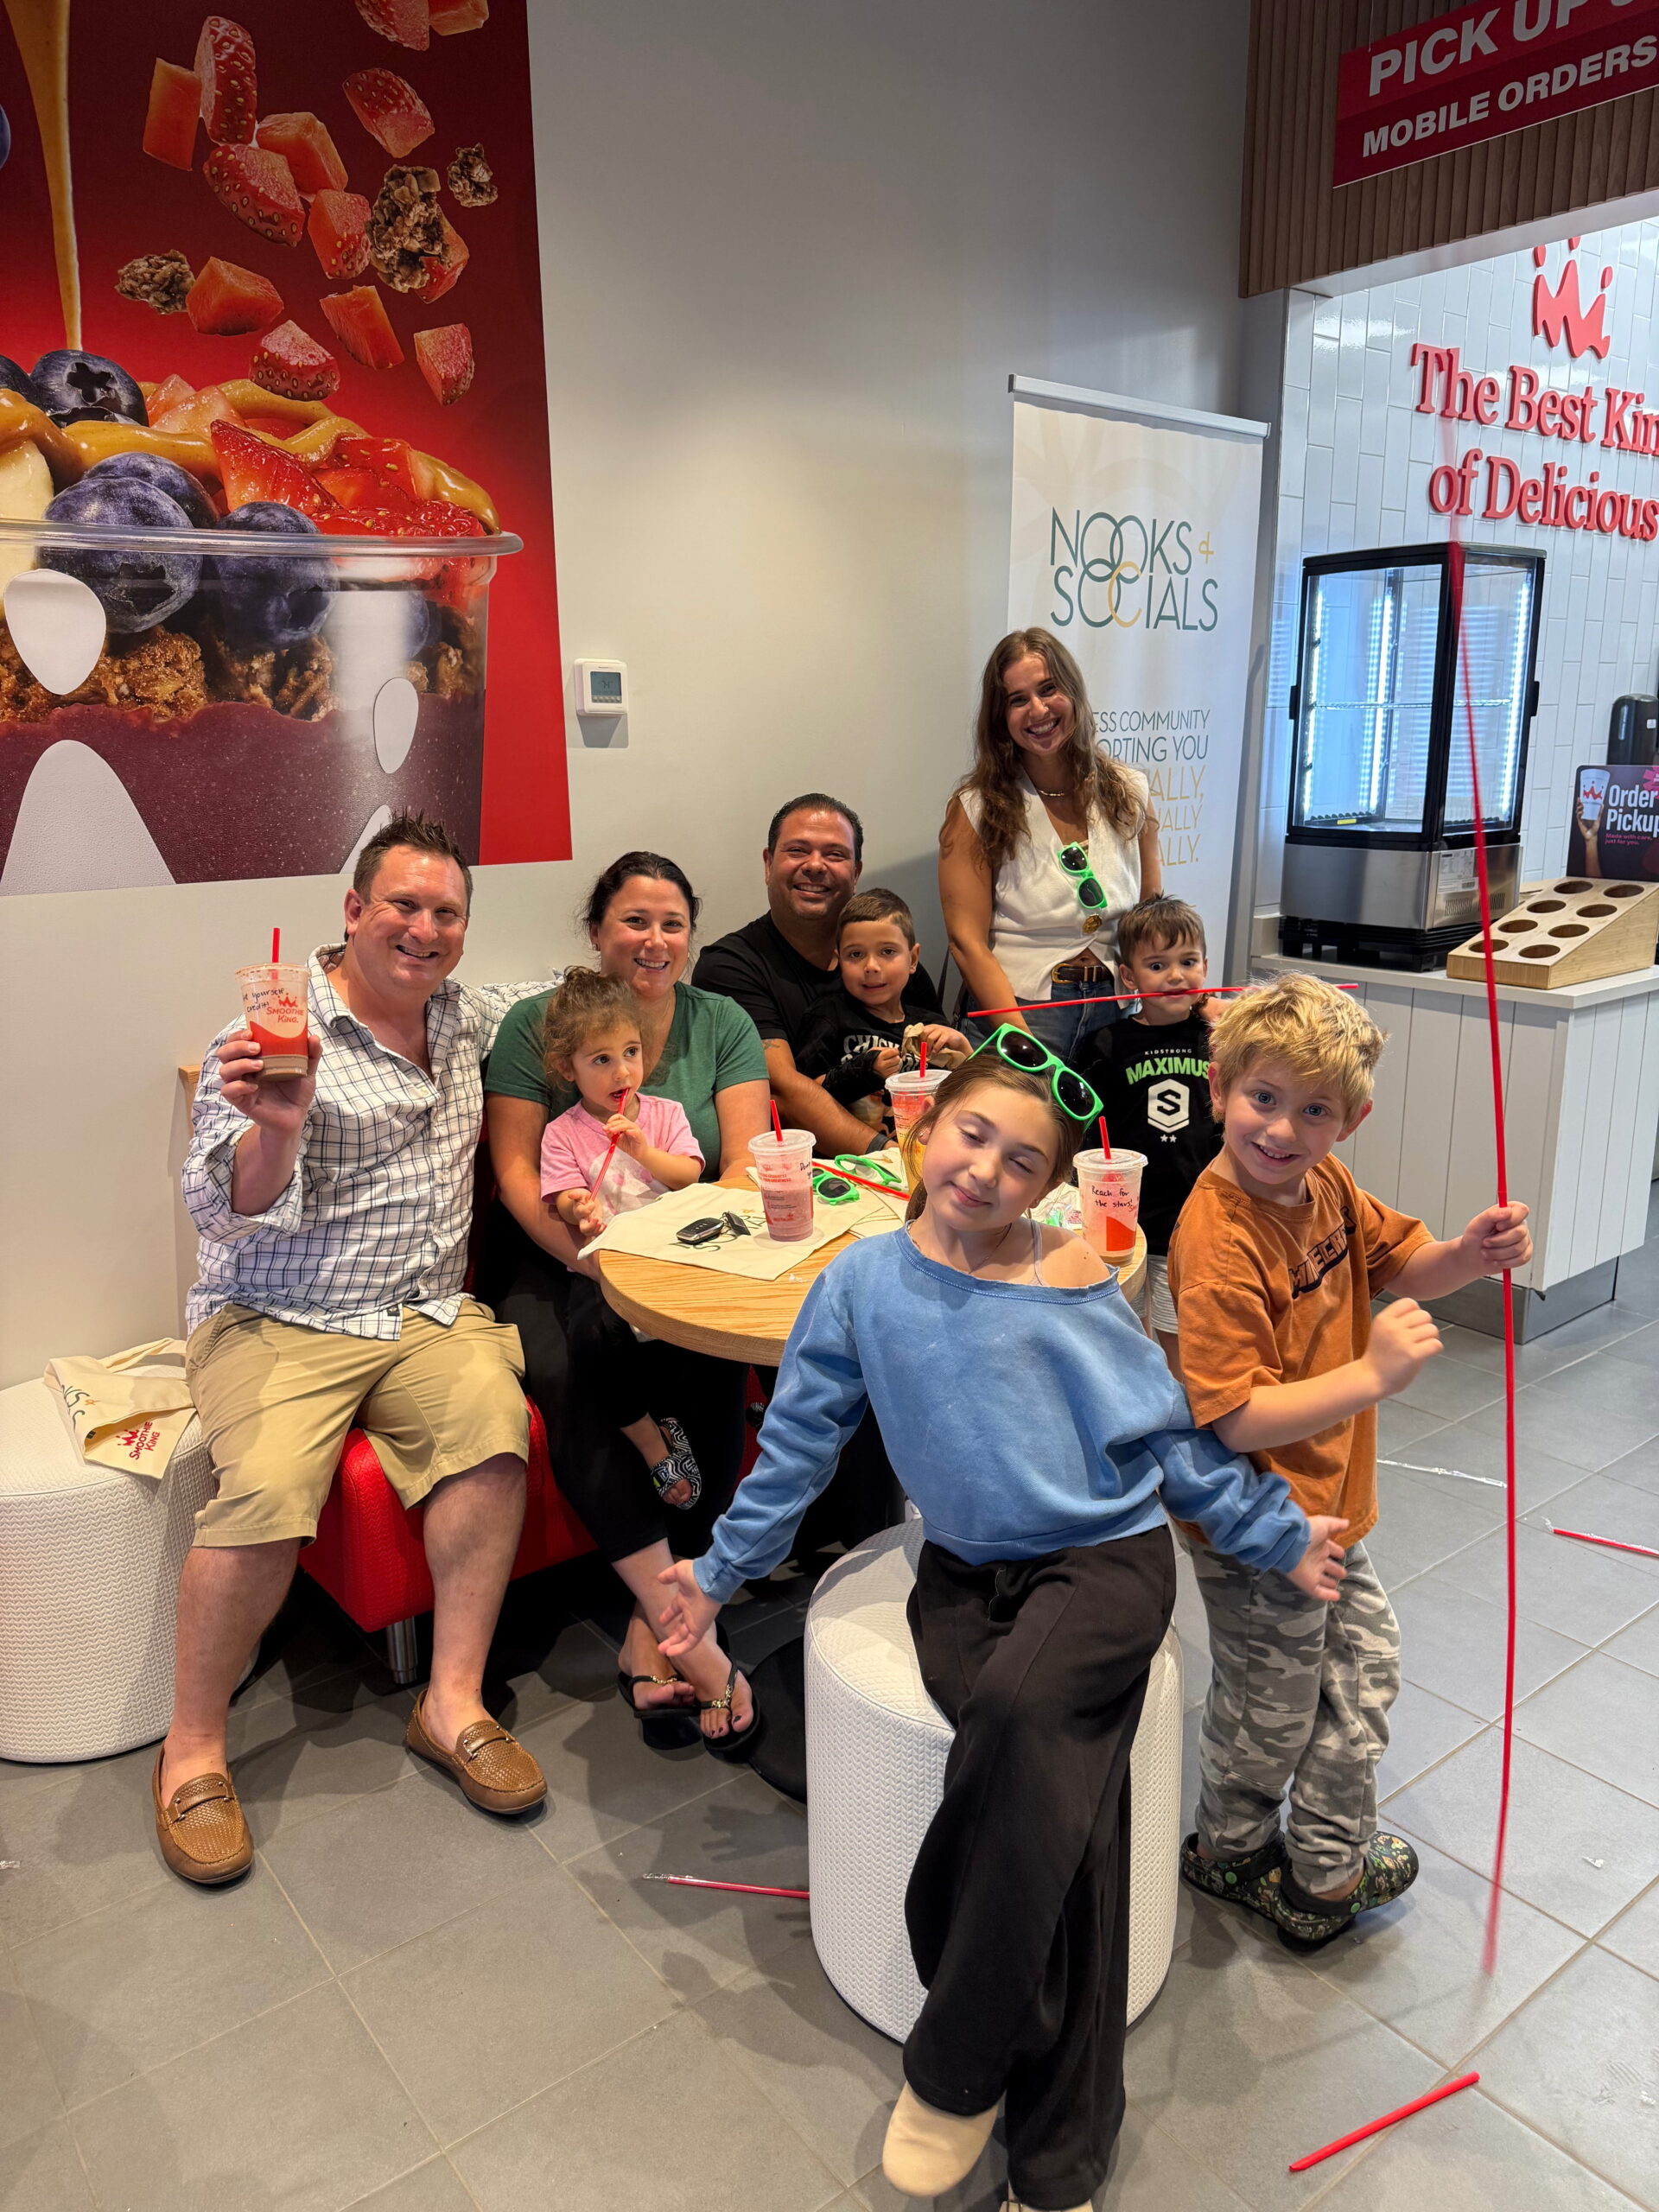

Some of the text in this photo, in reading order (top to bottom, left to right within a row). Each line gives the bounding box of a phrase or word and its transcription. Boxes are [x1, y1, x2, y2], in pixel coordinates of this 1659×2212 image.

[1369, 0, 1588, 97] PICK UP
[1363, 35, 1658, 158] MOBILE ORDERS
[1411, 343, 1500, 425] The
[1504, 365, 1598, 443] Best
[1429, 448, 1659, 541] of Delicious
[1051, 506, 1192, 584] NOOKS
[1051, 558, 1218, 632] SOCIALS
[1120, 709, 1211, 732] COMMUNITY
[1173, 734, 1209, 761] YOU
[1608, 784, 1657, 808] Order
[266, 1007, 304, 1016] SMOOTHIE
[1125, 1057, 1210, 1085] MAXIMUS
[1091, 1185, 1129, 1197] Reach for
[1095, 1199, 1108, 1208] the
[129, 1421, 153, 1460] SMOOTHIE
